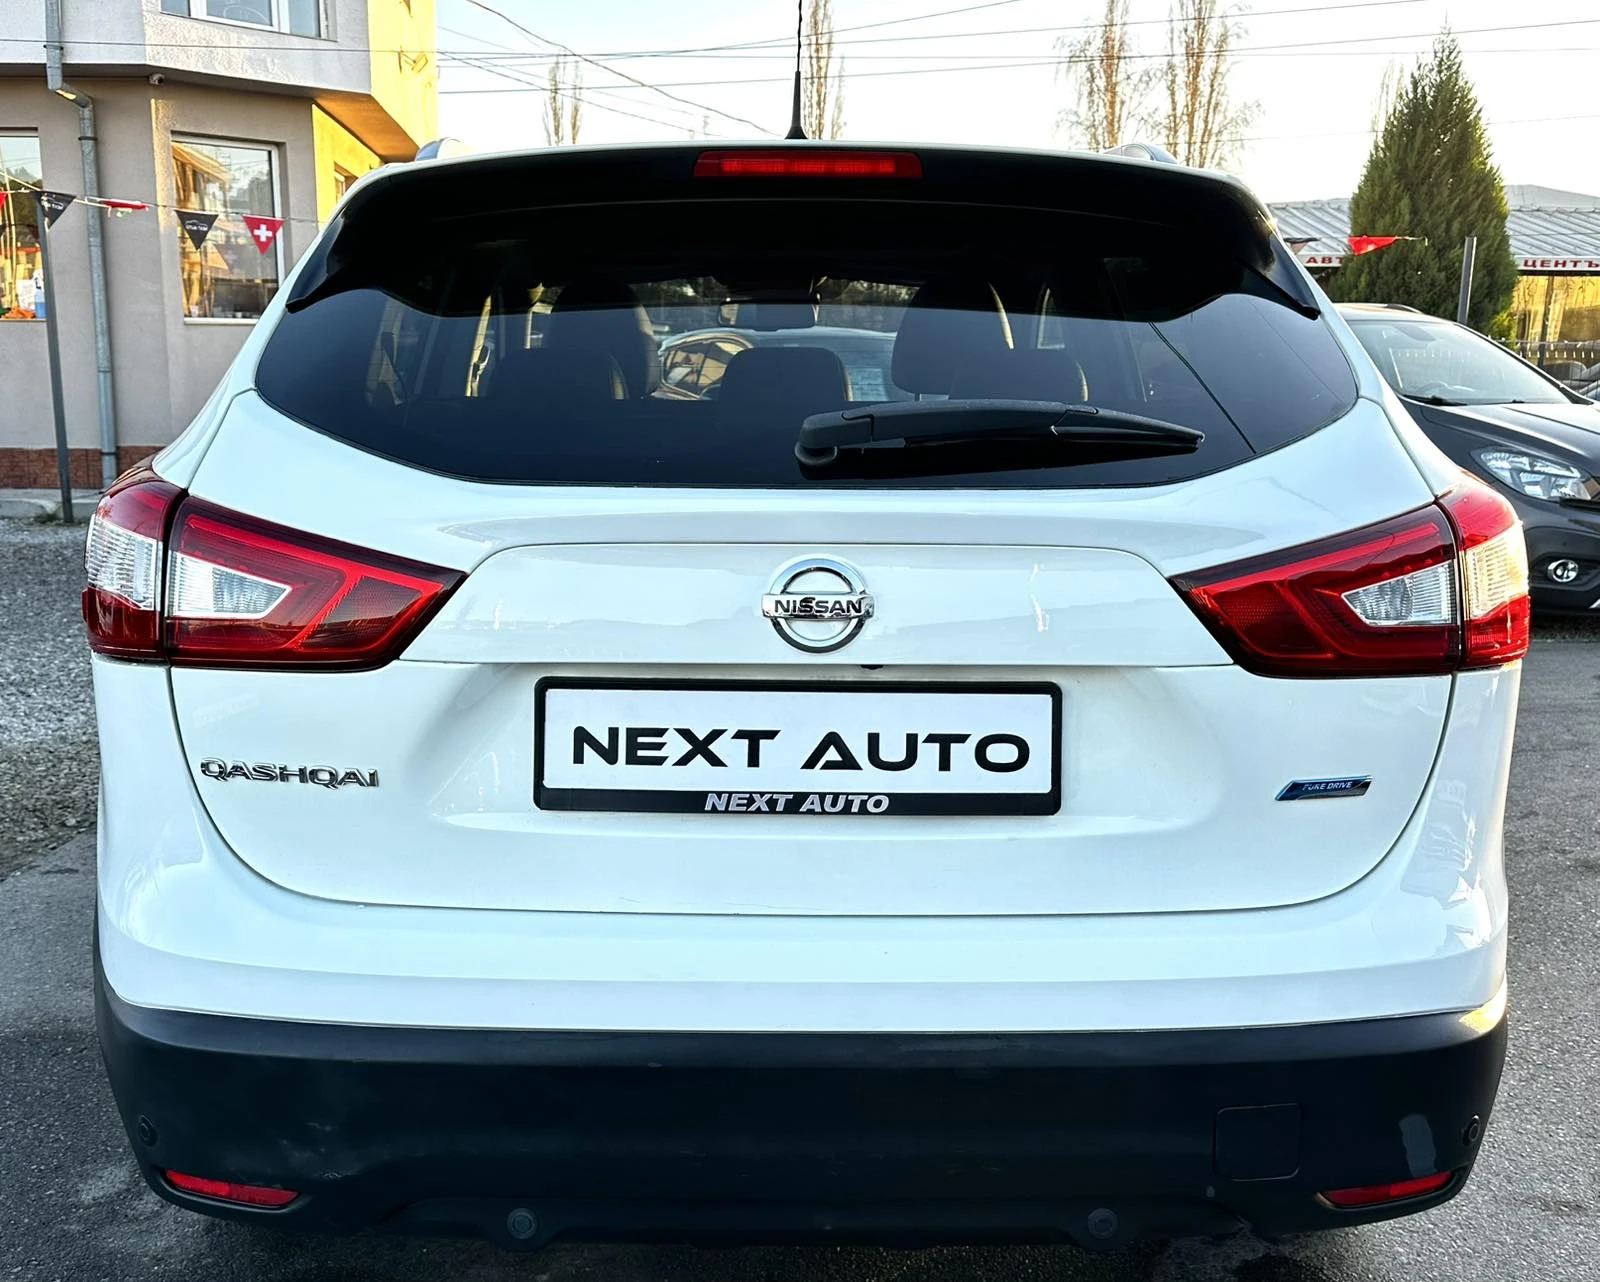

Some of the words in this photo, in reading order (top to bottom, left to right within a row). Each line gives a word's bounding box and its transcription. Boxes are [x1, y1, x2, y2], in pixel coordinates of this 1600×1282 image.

[774, 598, 863, 614] NISSAN
[572, 726, 782, 768] NEXT
[801, 730, 1030, 773] AUTO
[200, 757, 380, 789] QASHQAI
[1326, 781, 1354, 790] DRIVE
[704, 793, 793, 812] NEXT
[799, 794, 890, 813] AUTO
